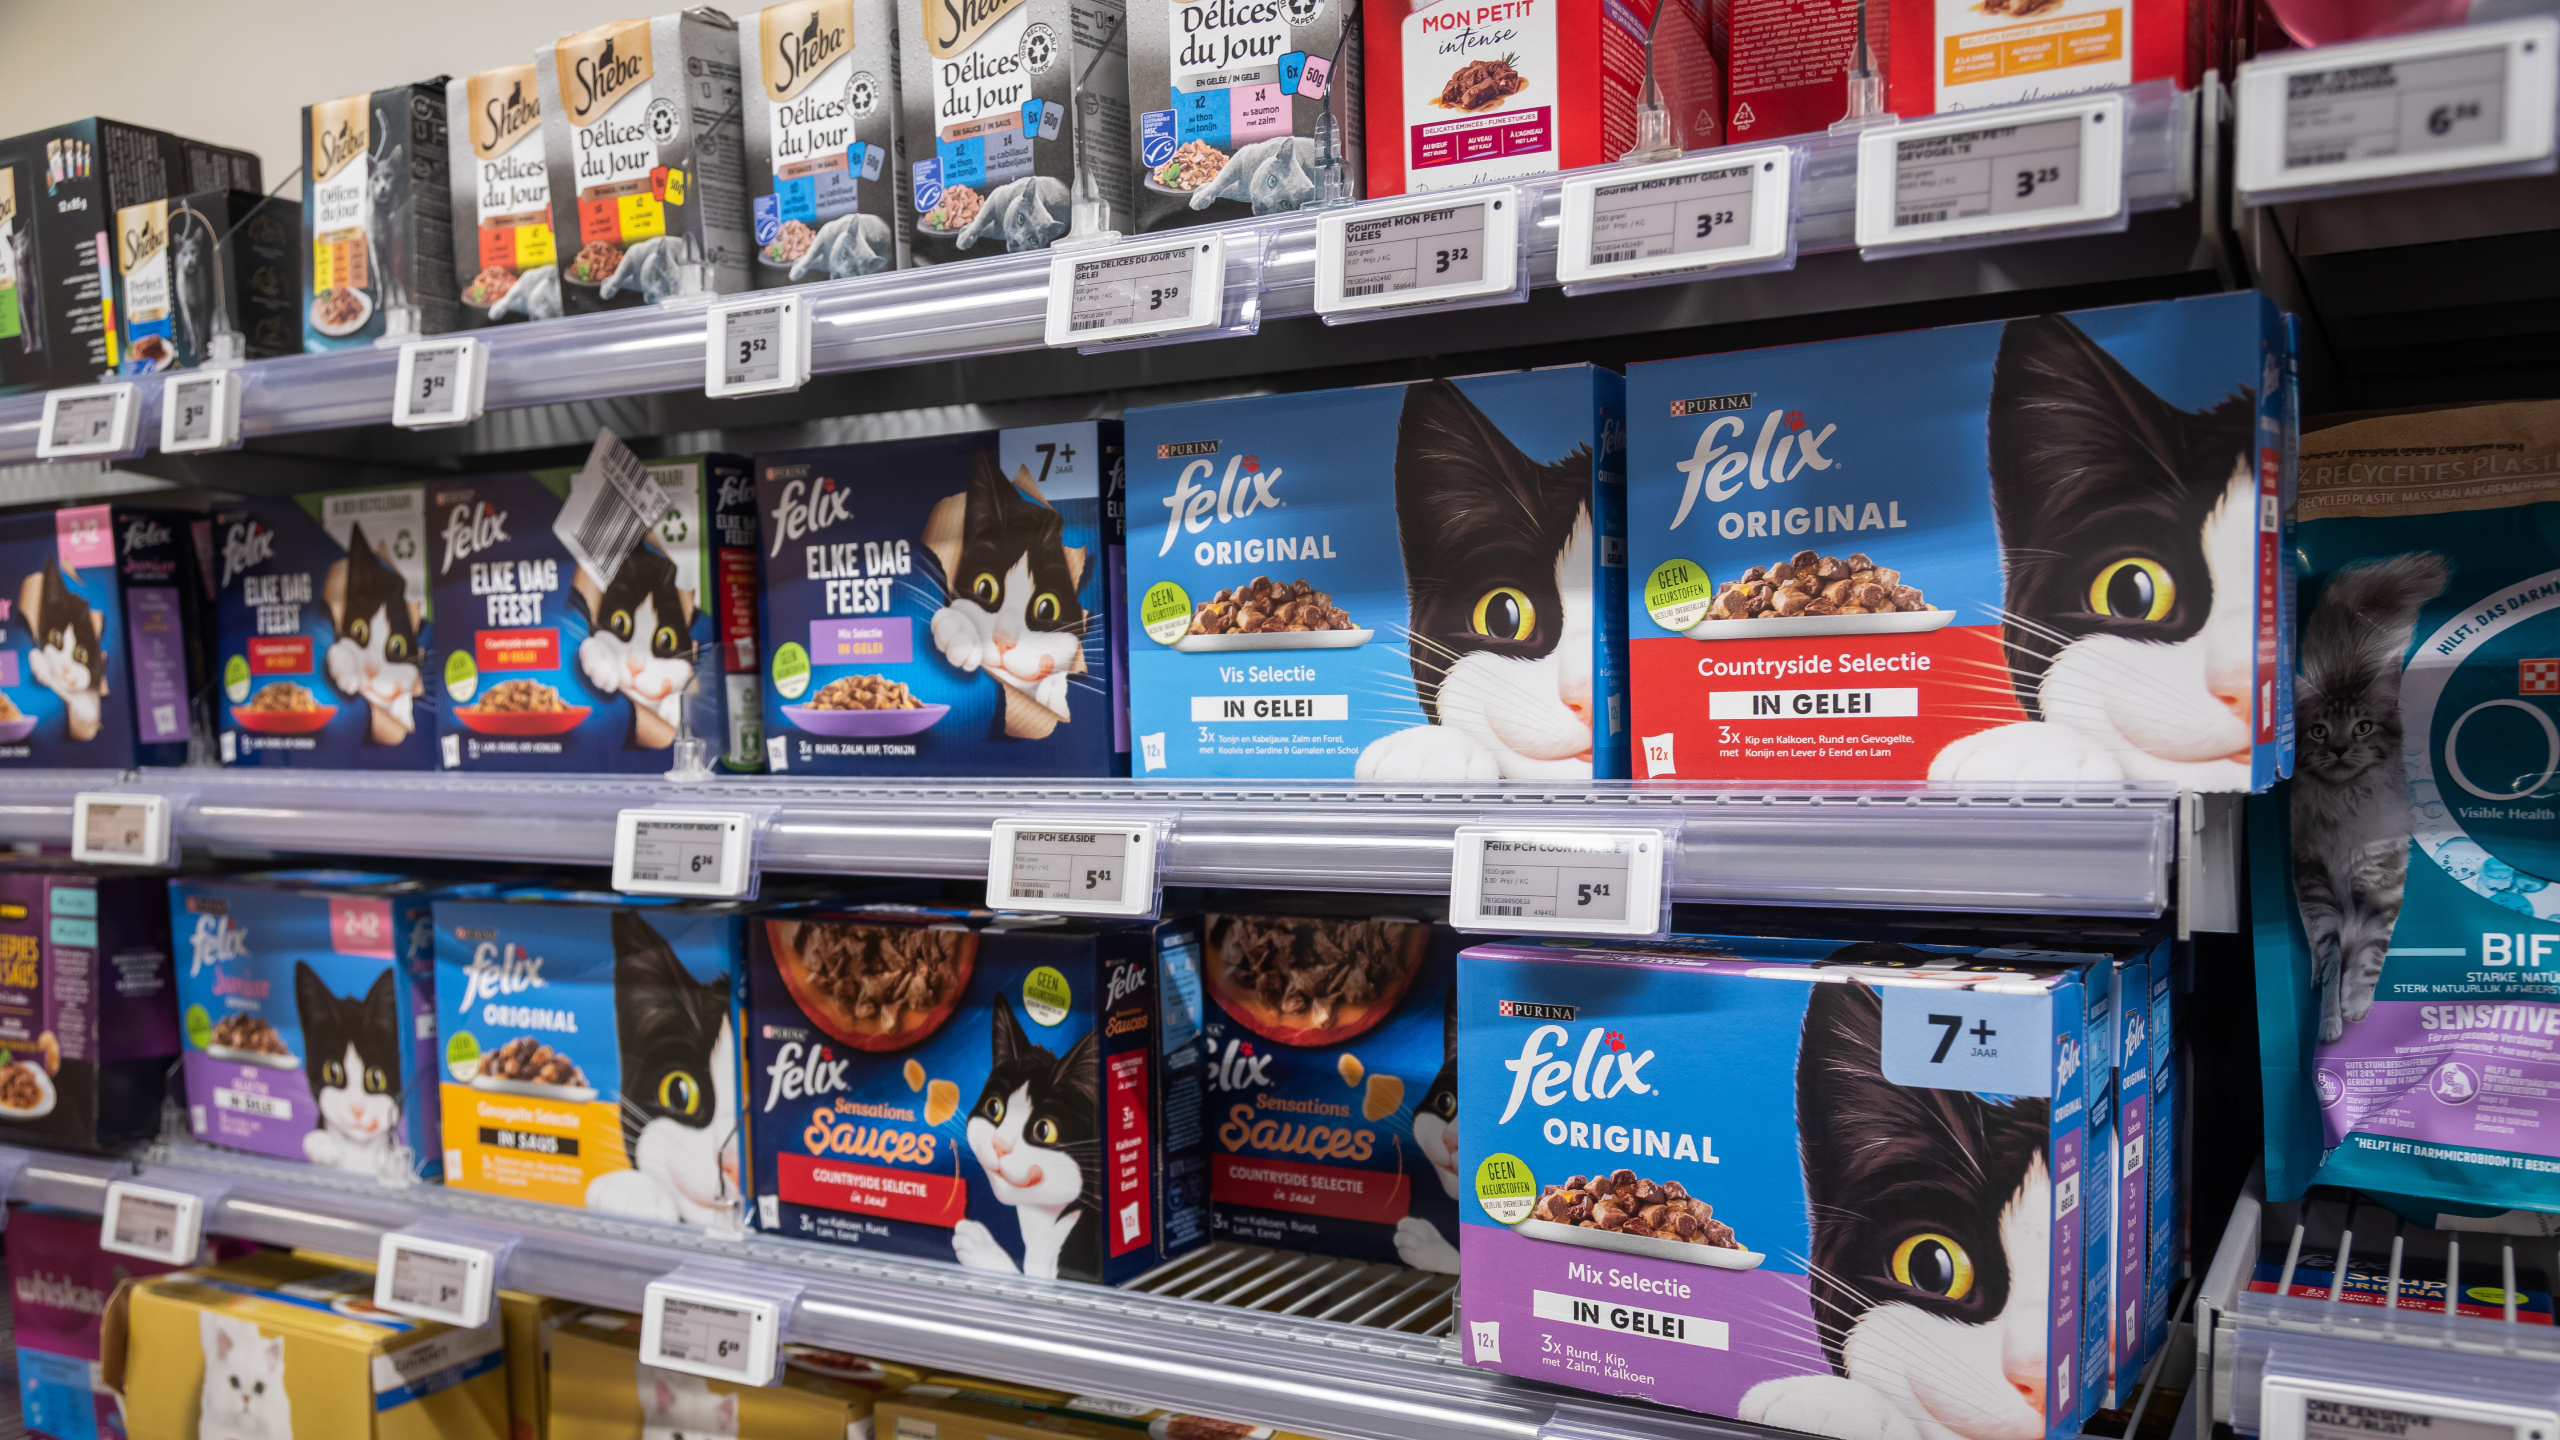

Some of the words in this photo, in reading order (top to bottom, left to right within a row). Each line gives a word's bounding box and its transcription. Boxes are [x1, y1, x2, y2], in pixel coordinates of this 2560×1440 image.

[1181, 0, 1277, 33] Délices
[1423, 11, 1474, 34] MON
[1477, 0, 1534, 25] PETIT
[1179, 37, 1215, 67] du
[1217, 34, 1281, 69] Jour
[1438, 27, 1518, 56] intense
[942, 51, 1019, 88] Délices
[1286, 65, 1298, 79] 6x
[1306, 67, 1324, 87] 50g
[942, 91, 972, 118] du
[974, 82, 1023, 119] Jour
[1596, 184, 1639, 197] Gourmet
[1642, 179, 1666, 190] MON
[1669, 174, 1699, 186] PETIT
[1701, 171, 1728, 182] GIGA
[1731, 168, 1748, 177] VIS
[1347, 219, 1391, 233] Gourmet
[1395, 215, 1420, 227] MON
[1423, 210, 1455, 223] PETIT
[1347, 230, 1381, 243] VLEES
[1076, 264, 1099, 273] Sheba
[1101, 259, 1134, 269] DELICES
[1136, 256, 1147, 264] DU
[1149, 253, 1170, 262] JOUR
[1173, 250, 1186, 258] VIS
[1076, 271, 1099, 280] GELEI
[1687, 396, 1750, 413] PURINA
[1170, 441, 1217, 457] PURINA
[1054, 464, 1074, 474] JAAR
[1670, 409, 1838, 531] felix
[2316, 461, 2465, 486] RECYCELTES
[770, 475, 852, 559] felix
[1159, 454, 1283, 557] felix
[1718, 501, 1907, 540] ORIGINAL
[440, 501, 508, 576] felix
[1194, 535, 1337, 566] ORIGINAL
[806, 543, 861, 581] ELKE
[865, 539, 912, 577] DAG
[470, 562, 515, 596] ELKE
[519, 558, 559, 592] DAG
[1658, 565, 1689, 590] GEEN
[825, 577, 893, 615] FEEST
[1150, 587, 1174, 608] GEEN
[1651, 584, 1705, 607] KLEURSTOFFEN
[487, 593, 543, 628] FEEST
[1147, 603, 1187, 623] KLEURSTOFFEN
[2475, 603, 2508, 627] DAS
[1219, 666, 1245, 683] Vis
[1249, 665, 1316, 683] Selectie
[1697, 655, 1832, 680] Countryside
[1838, 652, 1931, 673] Selectie
[1223, 700, 1245, 718] IN
[1253, 699, 1313, 718] GELEI
[1753, 694, 1781, 715] IN
[1792, 692, 1872, 715] GELEI
[1198, 726, 1216, 743] 3x
[1219, 735, 1240, 744] Tonijn
[1252, 734, 1290, 745] Kabeljauw,
[1291, 734, 1311, 743] Zalm
[1323, 734, 1345, 744] Forel,
[1718, 725, 1741, 744] 3x
[1745, 735, 1760, 746] Kip
[1776, 734, 1817, 746] Kalkoen,
[1818, 734, 1844, 744] Rund
[1846, 736, 1859, 744] en
[1861, 734, 1915, 747] Gevogelte,
[1199, 746, 1214, 754] met
[1219, 745, 1246, 754] Koolvis
[1256, 745, 1283, 754] Sardine
[1291, 745, 1325, 754] Garnalen
[1337, 745, 1359, 754] Schol
[1650, 747, 1669, 762] 12x
[1719, 749, 1739, 758] met
[1745, 748, 1775, 760] Konijn
[1776, 750, 1789, 758] en
[1791, 748, 1817, 758] Lever
[1818, 748, 1826, 758] &
[1828, 748, 1853, 758] Eend
[1855, 749, 1868, 758] en
[1870, 748, 1892, 758] Lam
[2458, 806, 2504, 819] Visible
[2509, 808, 2555, 820] Health
[1016, 833, 1036, 841] Felix
[1038, 834, 1056, 842] PCH
[1058, 834, 1096, 843] SEASIDE
[1485, 842, 1511, 852] Felix
[1513, 843, 1537, 852] PCH
[459, 941, 545, 1015] felix
[2394, 984, 2429, 993] STERK
[2432, 984, 2501, 993] NATUURLIJK
[483, 1003, 578, 1034] ORIGINAL
[1514, 1004, 1573, 1020] PURINA
[2421, 1005, 2560, 1036] SENSITIVE
[1105, 1014, 1148, 1039] Sauces
[1969, 1047, 1998, 1060] JAAR
[764, 1042, 849, 1113] felix
[1499, 1024, 1655, 1125] felix
[835, 1097, 914, 1122] Sensations
[1256, 1093, 1350, 1118] Sensations
[498, 1130, 514, 1147] IN
[517, 1134, 558, 1154] SAUS
[803, 1106, 937, 1165] Sauces
[1219, 1103, 1376, 1161] Sauces
[1543, 1118, 1720, 1165] ORIGINAL
[2392, 1142, 2412, 1155] HET
[813, 1168, 880, 1191] COUNTRYSIDE
[882, 1178, 928, 1198] SELECTIE
[1229, 1165, 1309, 1188] COUNTRYSIDE
[1311, 1176, 1364, 1194] SELECTIE
[1487, 1161, 1516, 1182] GEEN
[1481, 1181, 1531, 1196] KLEURSTOFFEN
[1568, 1262, 1603, 1285] Mix
[1608, 1268, 1691, 1299] Selectie
[1573, 1300, 1599, 1325] IN
[1610, 1308, 1685, 1340] GELEI
[1477, 1332, 1495, 1349] 12x
[1541, 1334, 1562, 1355] 3x
[1566, 1346, 1601, 1364] Rund,
[1605, 1353, 1629, 1369] Kip,
[1542, 1357, 1561, 1368] met
[1566, 1359, 1600, 1377] Zalm,
[1604, 1367, 1655, 1386] Kalkoen
